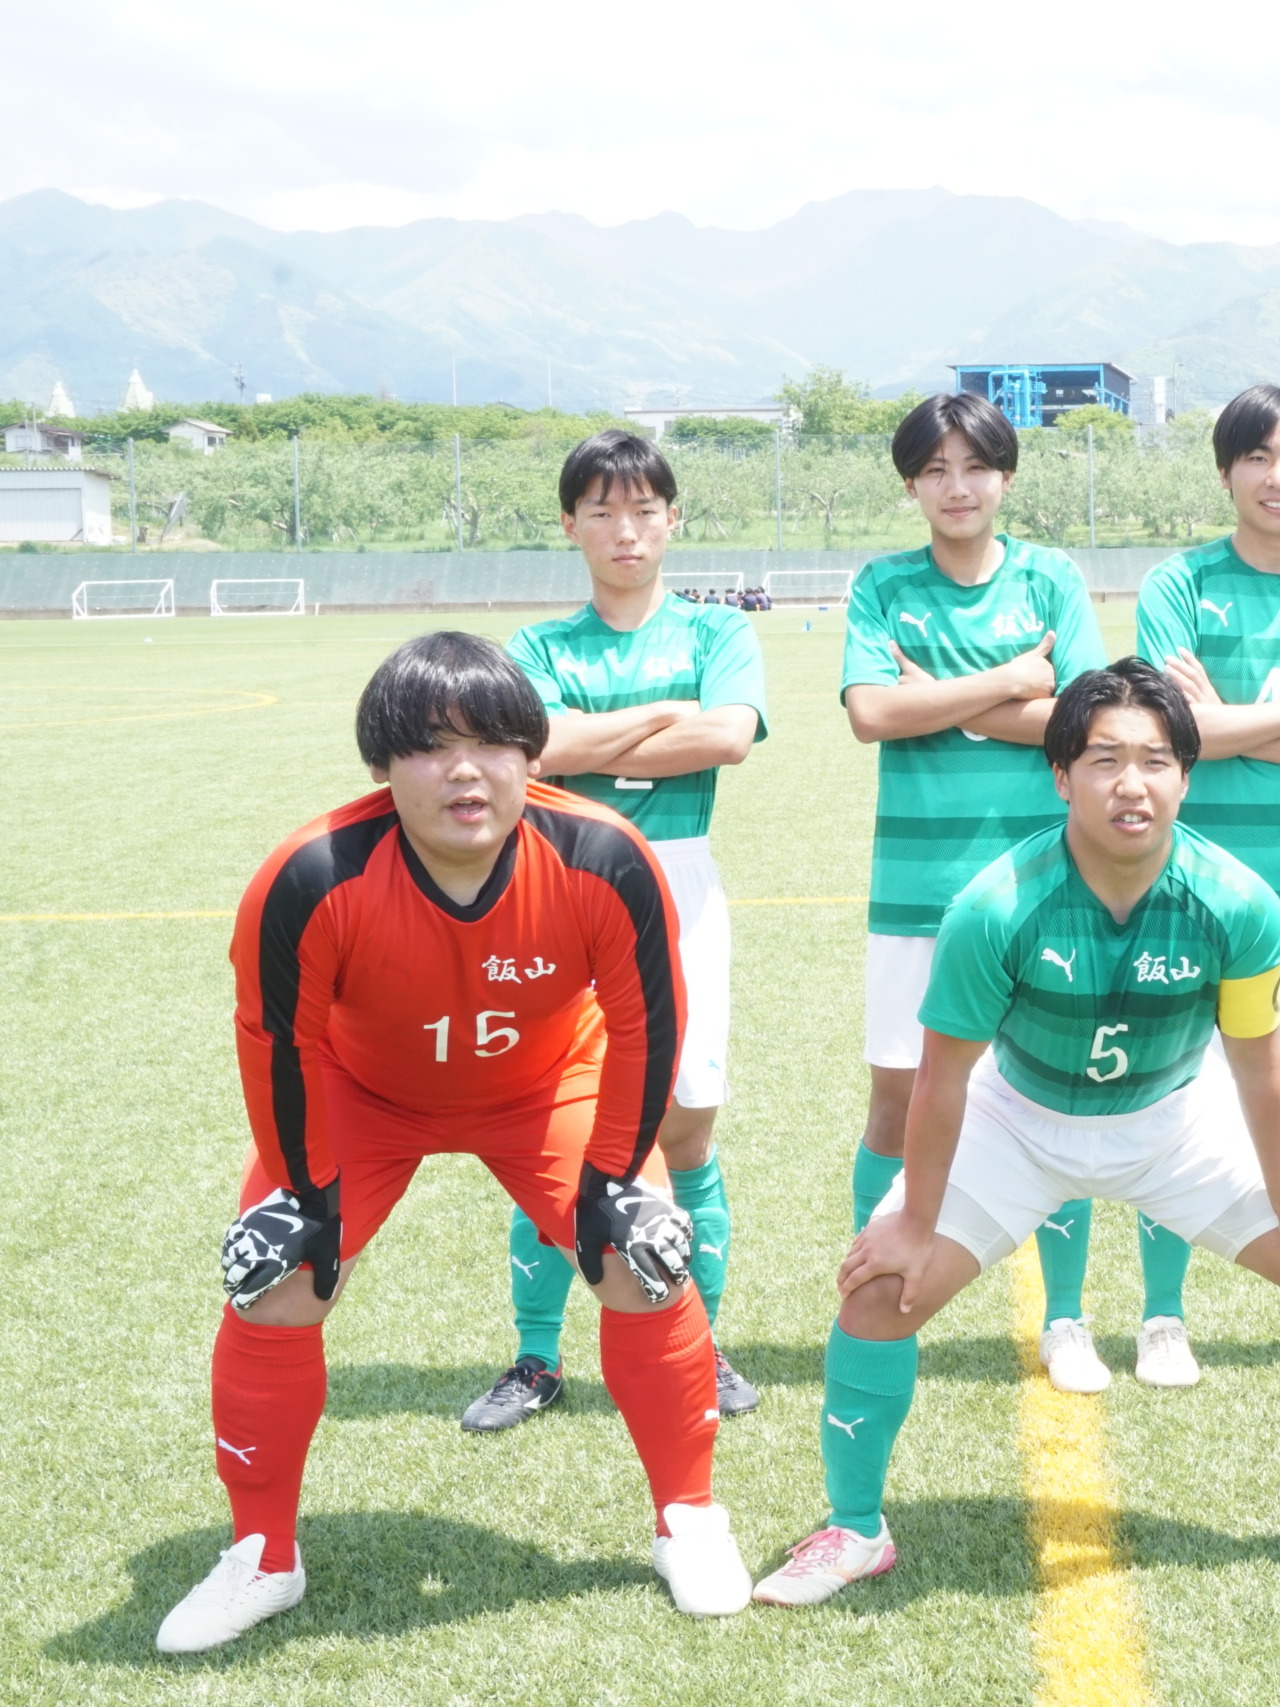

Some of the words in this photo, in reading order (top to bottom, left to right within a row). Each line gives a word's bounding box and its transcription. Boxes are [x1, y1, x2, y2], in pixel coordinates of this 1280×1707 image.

[481, 954, 557, 984] 飯山
[1133, 951, 1201, 984] 飯山
[423, 1010, 520, 1062] 15
[1086, 1023, 1129, 1082] 5
